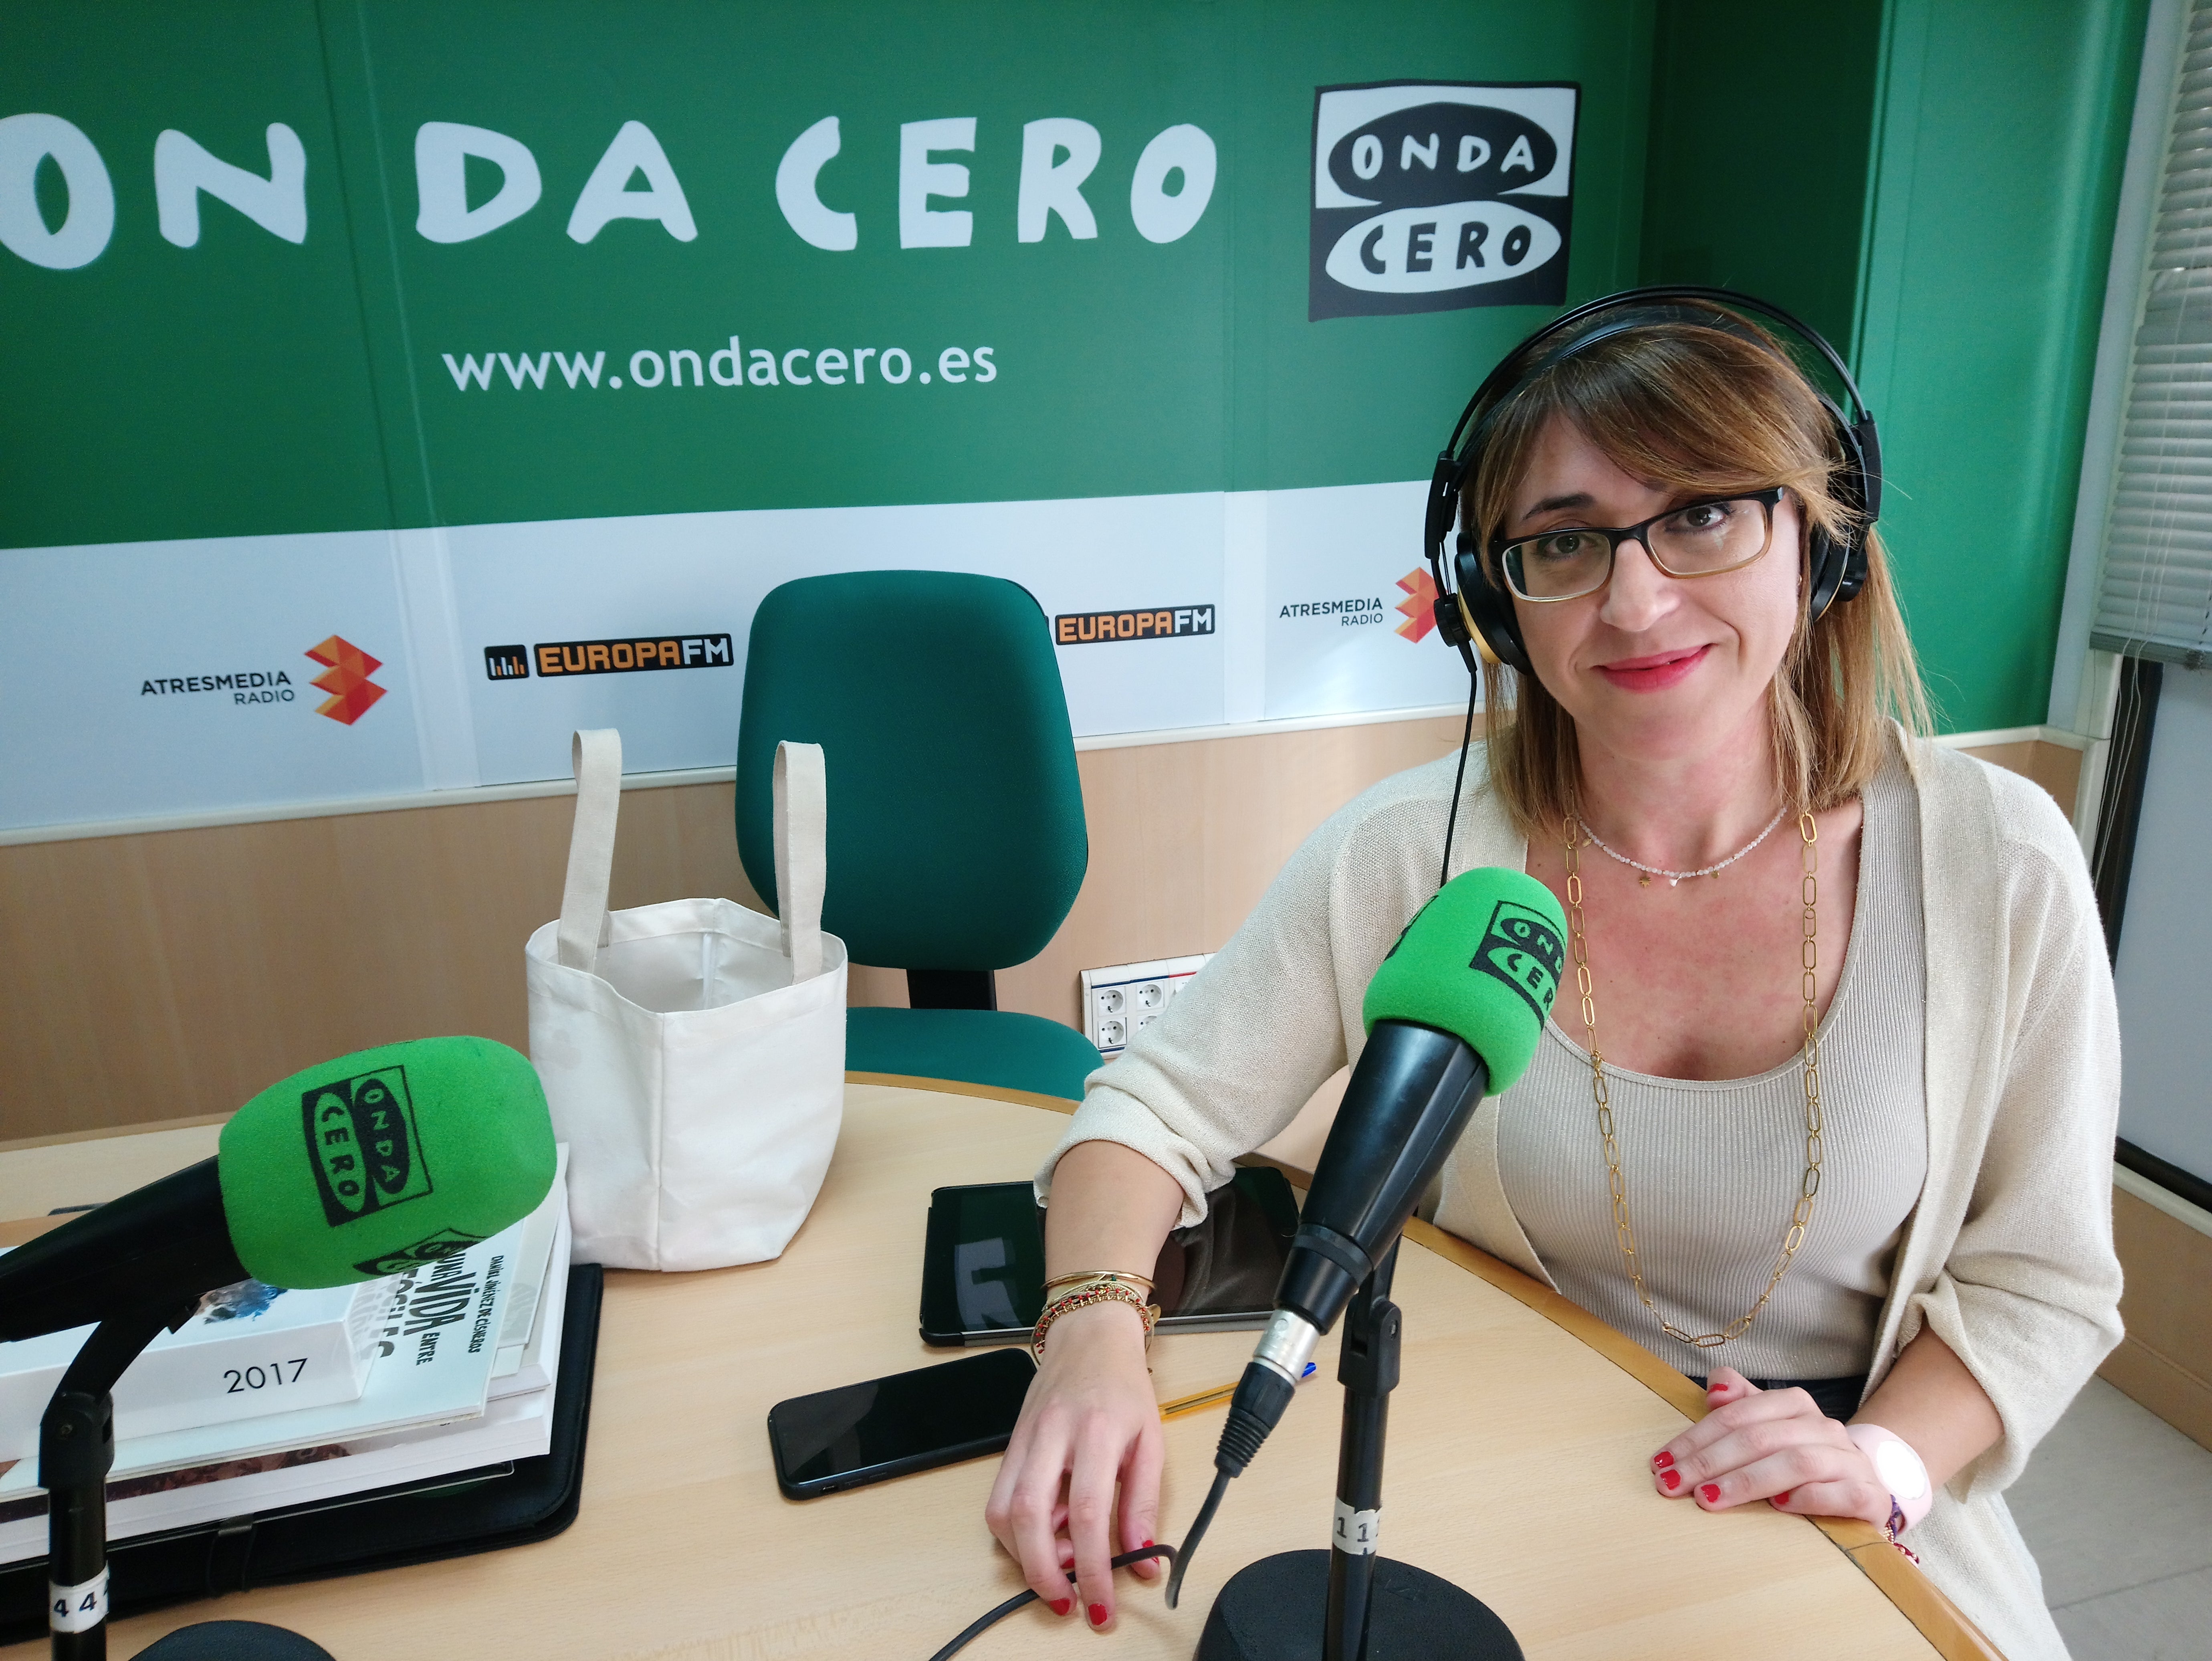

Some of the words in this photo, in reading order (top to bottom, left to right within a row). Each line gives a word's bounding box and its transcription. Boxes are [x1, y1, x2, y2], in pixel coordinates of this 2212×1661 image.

[1352, 133, 1534, 180] ONDA
[776, 116, 1217, 251] CERO
[1360, 221, 1531, 274] CERO
[442, 335, 997, 390] www.ondacero.es
[1280, 598, 1383, 618] ATRESMEDIA
[1342, 613, 1383, 626] RADIO
[141, 671, 291, 695] ATRESMEDIA
[234, 689, 295, 705] RADIO
[322, 1106, 359, 1196] CERO
[364, 1089, 400, 1182] ONDA
[430, 1252, 466, 1281] UNA
[476, 1308, 492, 1319] DE
[416, 1332, 440, 1366] ENTRE
[224, 1358, 308, 1394] 2017
